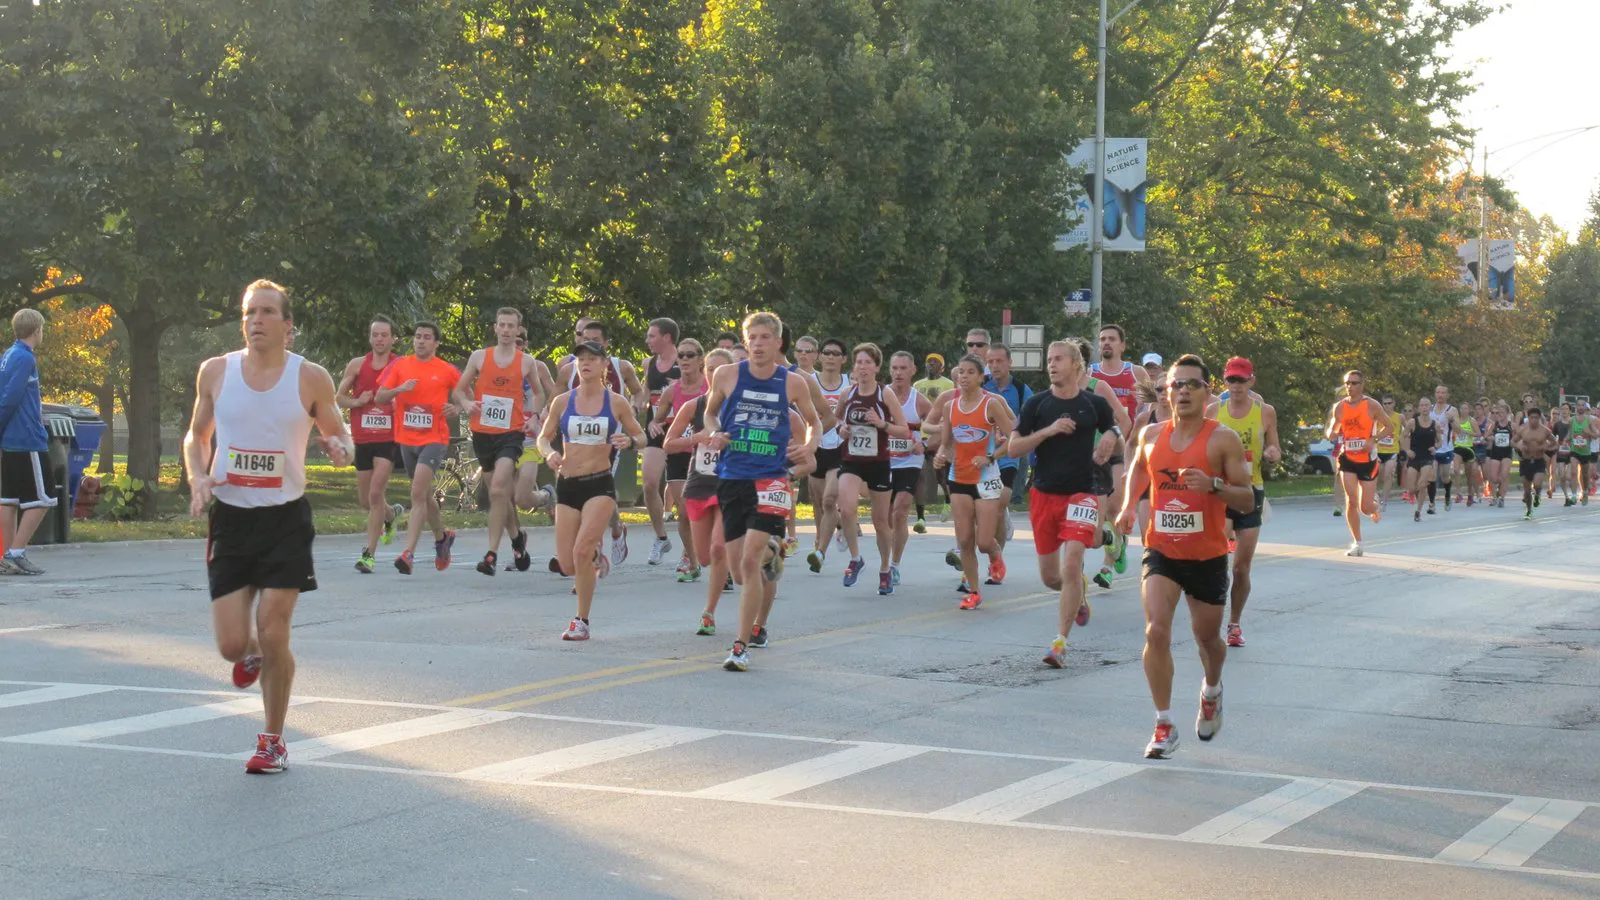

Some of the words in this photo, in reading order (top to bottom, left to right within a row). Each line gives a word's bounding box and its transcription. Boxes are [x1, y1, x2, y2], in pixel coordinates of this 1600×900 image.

[1106, 143, 1139, 160] NATURE
[1106, 157, 1140, 175] SCIENCE
[405, 413, 432, 425] A12115
[486, 407, 506, 420] 460
[576, 422, 600, 436] 140
[740, 428, 744, 439] I
[748, 429, 770, 442] RUN
[853, 436, 872, 449] 272
[750, 443, 779, 457] HOPE
[234, 453, 275, 472] A1646
[1161, 513, 1195, 529] B3254
